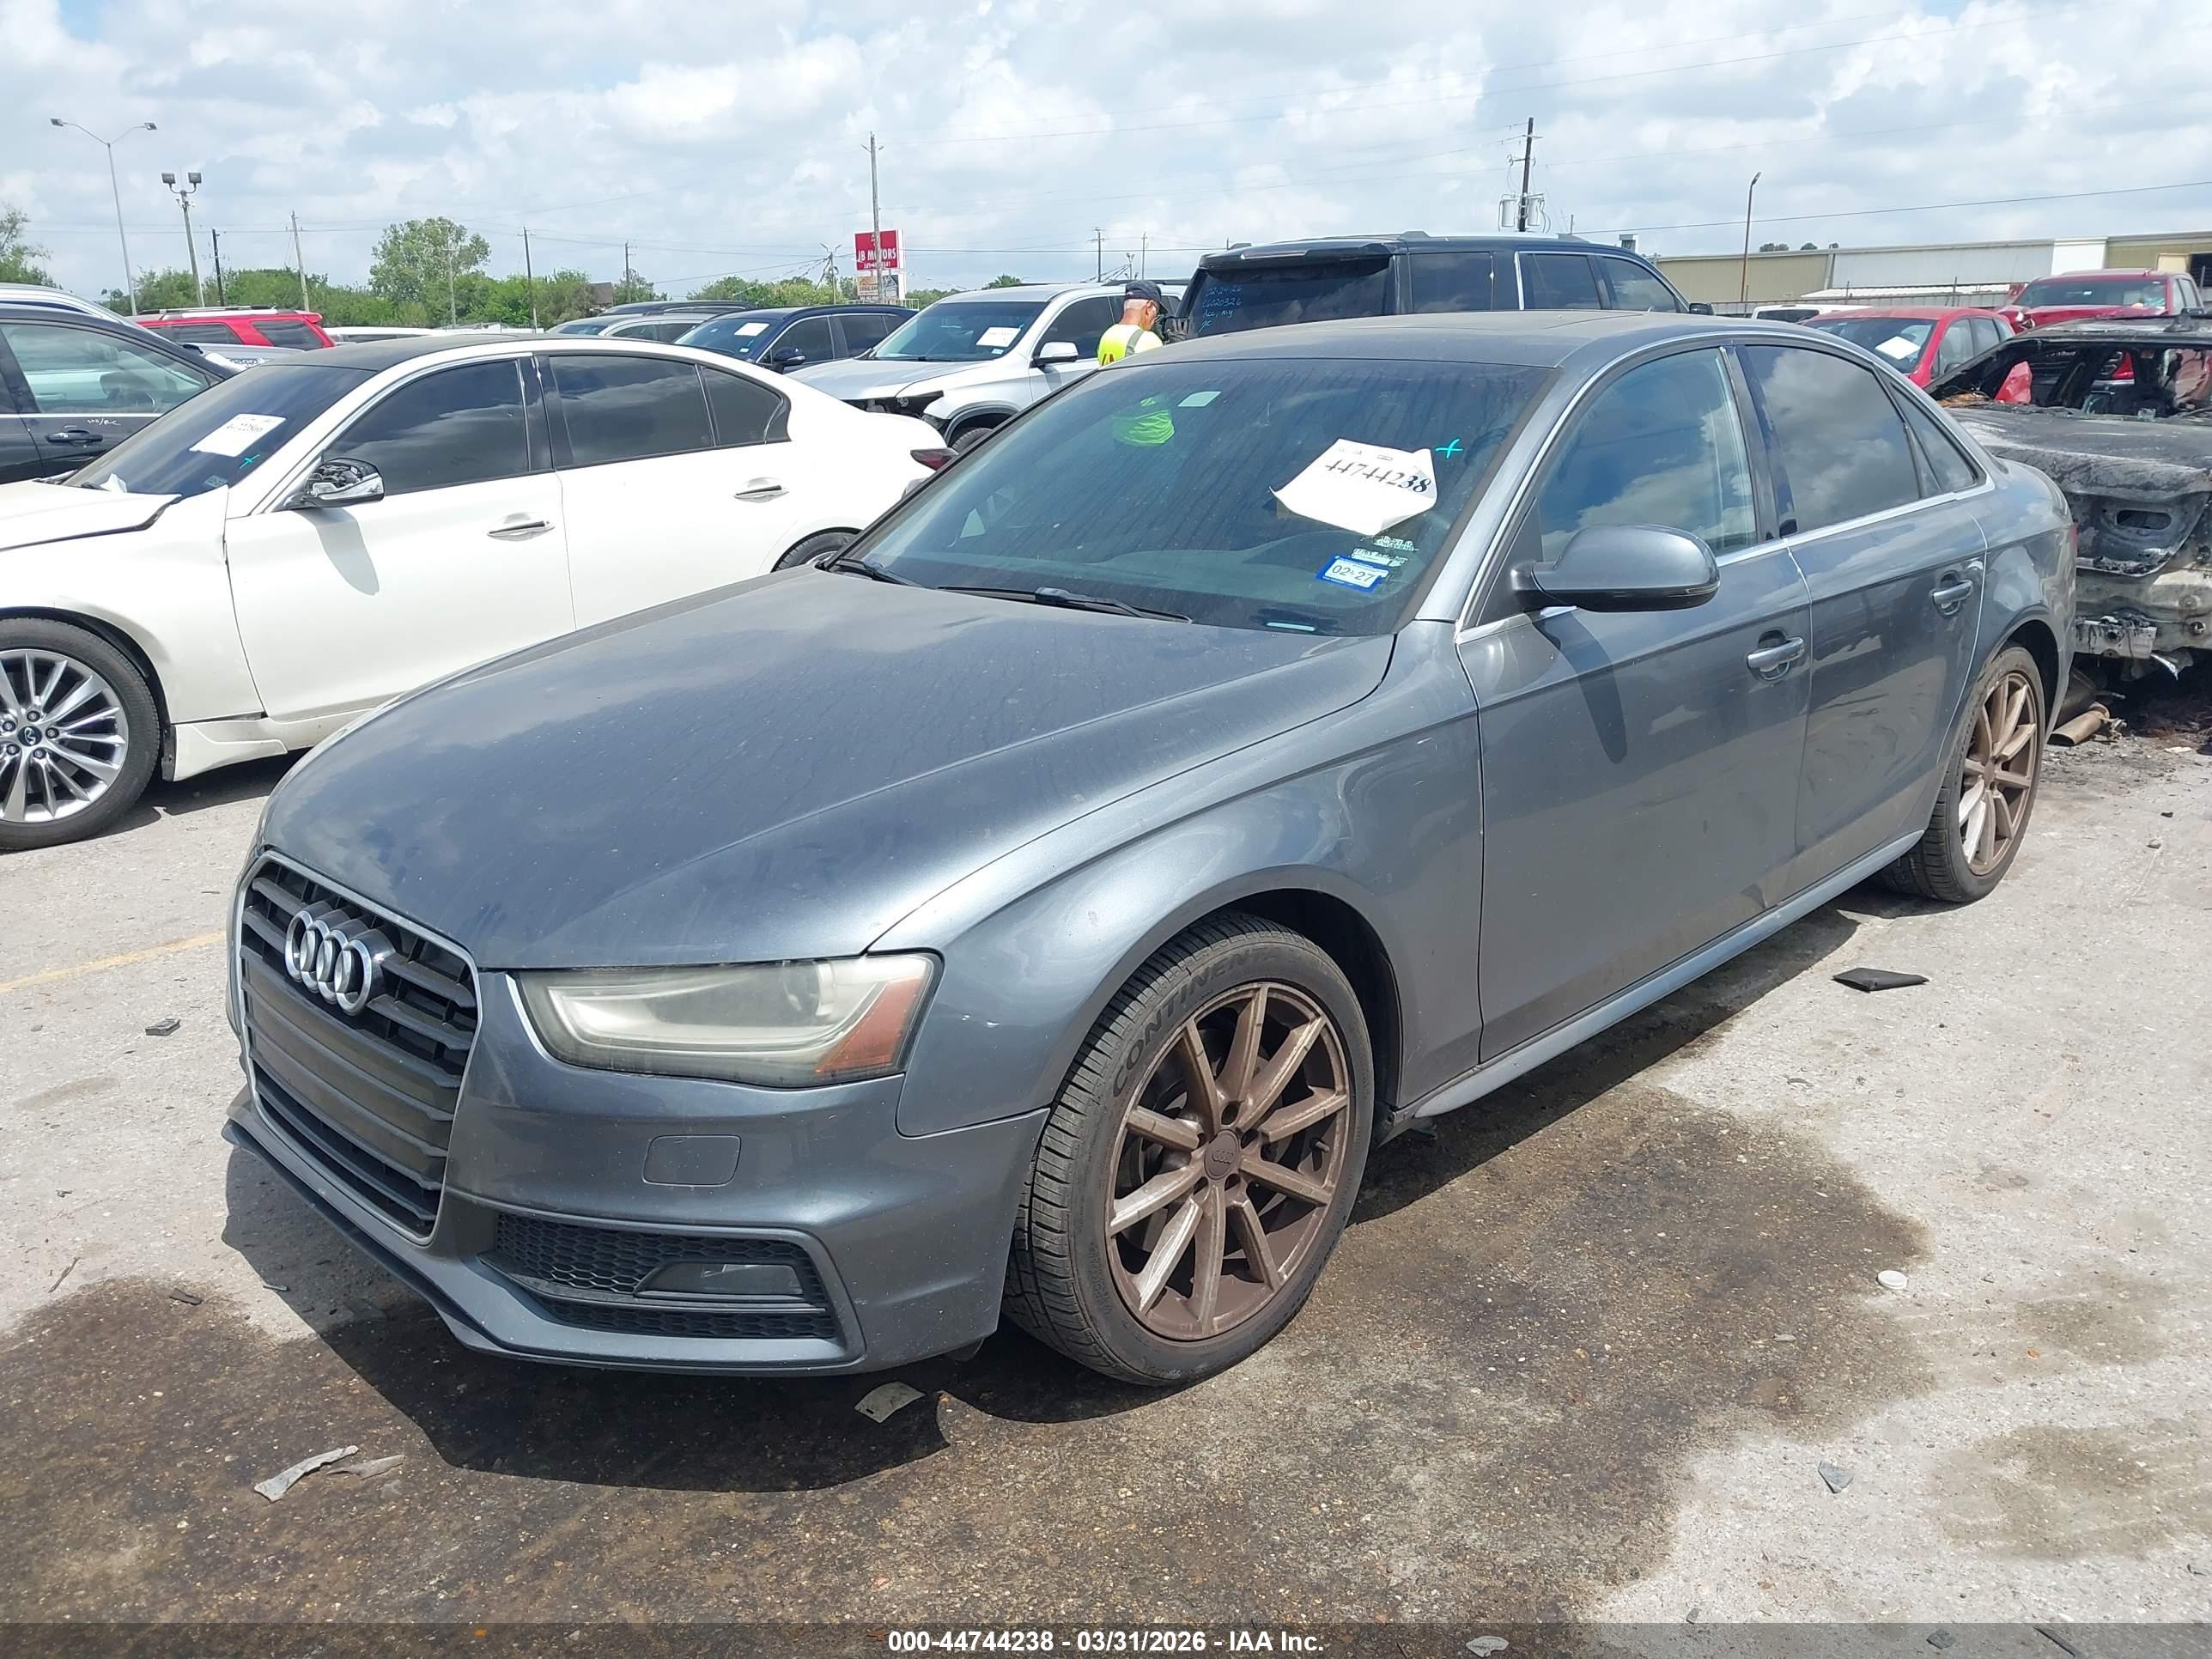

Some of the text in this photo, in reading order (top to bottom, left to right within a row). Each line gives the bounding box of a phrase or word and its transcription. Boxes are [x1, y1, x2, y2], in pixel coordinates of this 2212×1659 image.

[858, 248, 896, 261] JB MORS
[1325, 459, 1432, 493] 44744238
[1112, 947, 1291, 1097] CONTINEN
